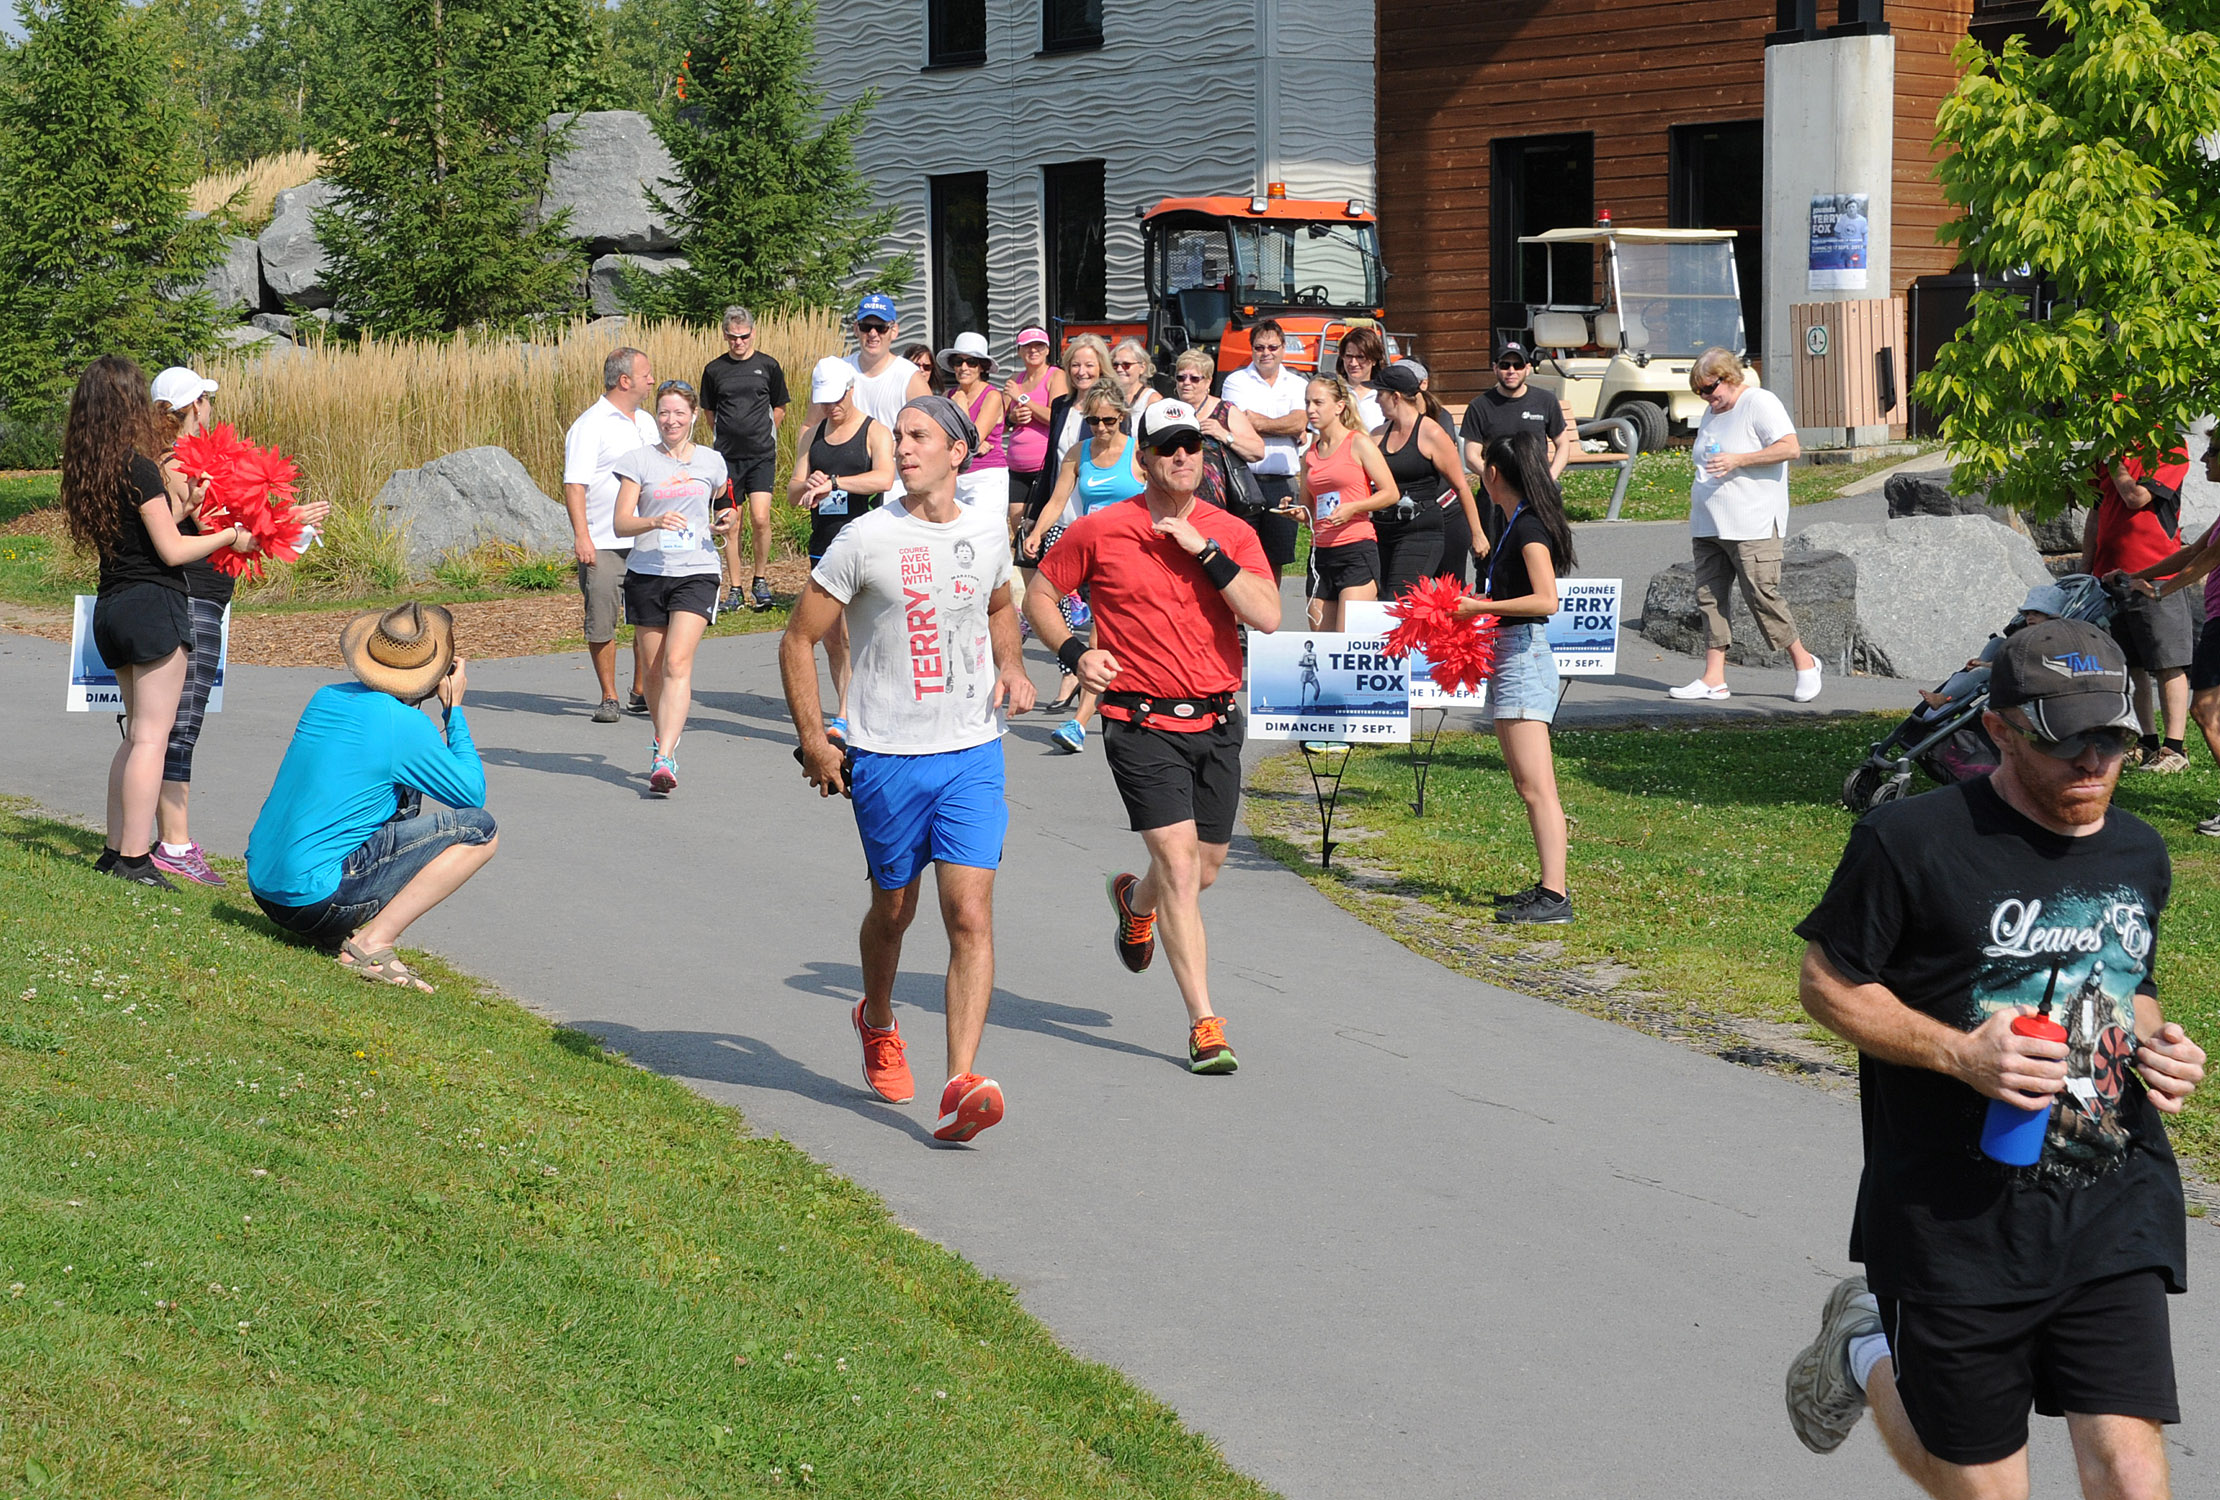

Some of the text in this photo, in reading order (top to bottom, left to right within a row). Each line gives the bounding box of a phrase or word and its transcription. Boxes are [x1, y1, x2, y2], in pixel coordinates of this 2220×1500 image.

[1812, 213, 1842, 224] TERRY
[1812, 224, 1831, 234] FOX
[653, 485, 705, 500] adidas
[899, 546, 929, 555] COUREZ
[900, 552, 931, 564] AVEC
[901, 562, 932, 576] RUN
[902, 574, 933, 586] WITH
[1568, 584, 1616, 596] JOURNÉE
[1573, 615, 1613, 631] FOX
[902, 587, 945, 701] TERRY
[1328, 653, 1404, 671] TERRY
[1559, 659, 1604, 668] 17 SEPT.
[2053, 651, 2104, 673] TML
[1356, 674, 1405, 692] FOX
[1265, 722, 1396, 734] DIMANCHE 17 SEPT.
